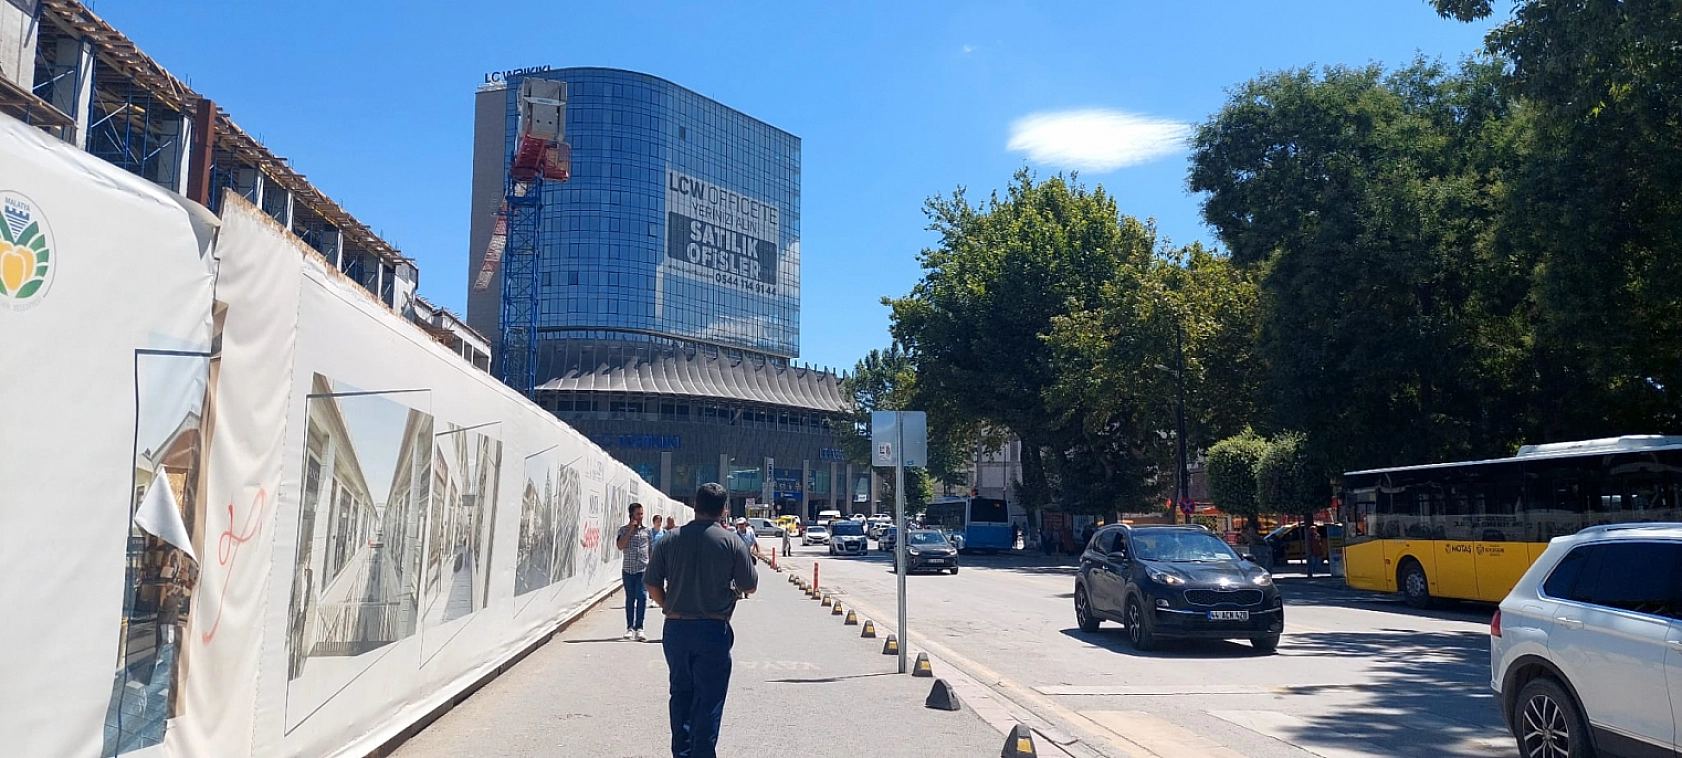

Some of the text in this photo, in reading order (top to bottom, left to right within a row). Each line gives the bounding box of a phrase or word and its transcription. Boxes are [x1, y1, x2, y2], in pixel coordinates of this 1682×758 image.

[485, 71, 501, 83] LC
[670, 172, 705, 200] LCW
[5, 196, 31, 211] MALATYA
[690, 220, 759, 259] SATILIK
[715, 272, 738, 286] 0544
